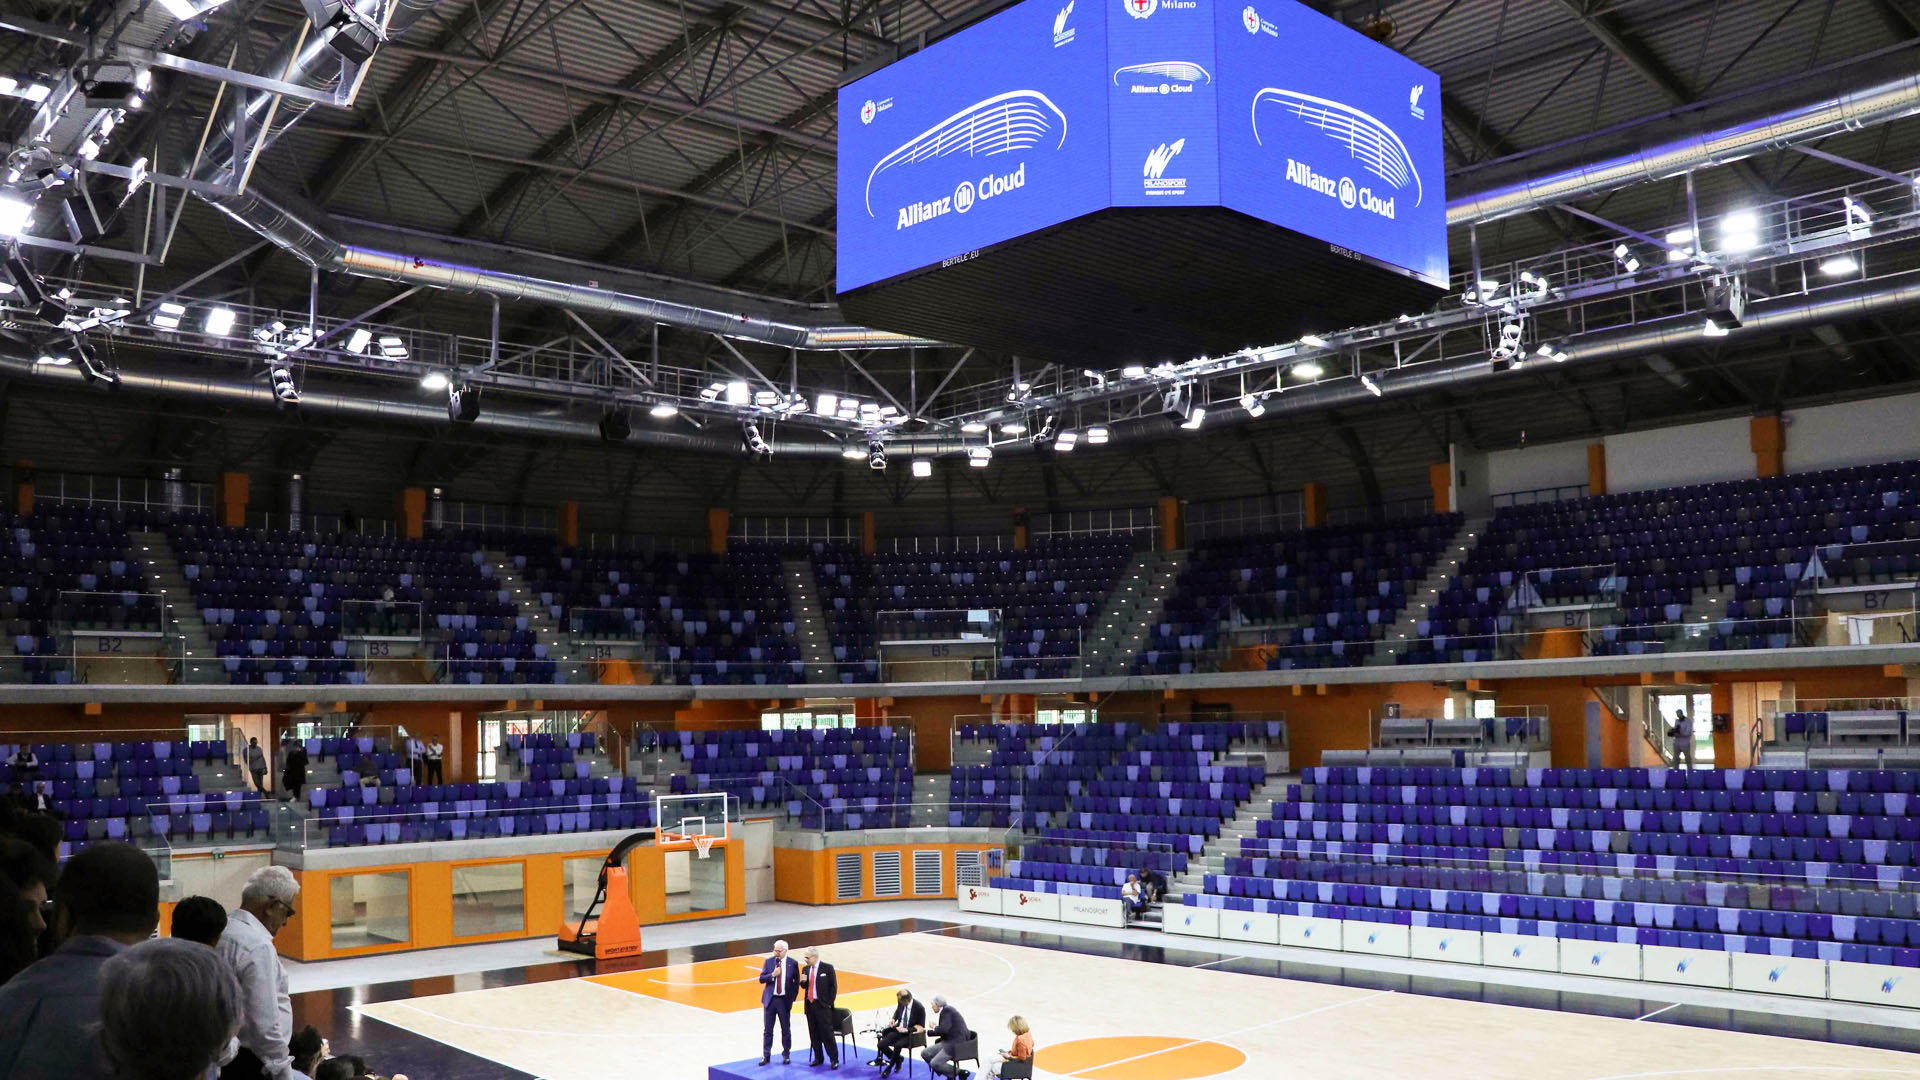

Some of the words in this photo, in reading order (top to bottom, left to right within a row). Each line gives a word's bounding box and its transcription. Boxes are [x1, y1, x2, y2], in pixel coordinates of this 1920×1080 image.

[1161, 0, 1197, 9] Milano
[1131, 85, 1158, 93] Allianz
[1171, 83, 1193, 93] Cloud
[896, 196, 951, 230] Allianz
[978, 161, 1025, 200] Cloud
[1286, 158, 1337, 198] Allianz
[1359, 187, 1395, 220] Cloud
[1864, 591, 1890, 609] B7
[1564, 611, 1585, 626] B7
[98, 637, 122, 652] B2
[370, 642, 389, 656] B3
